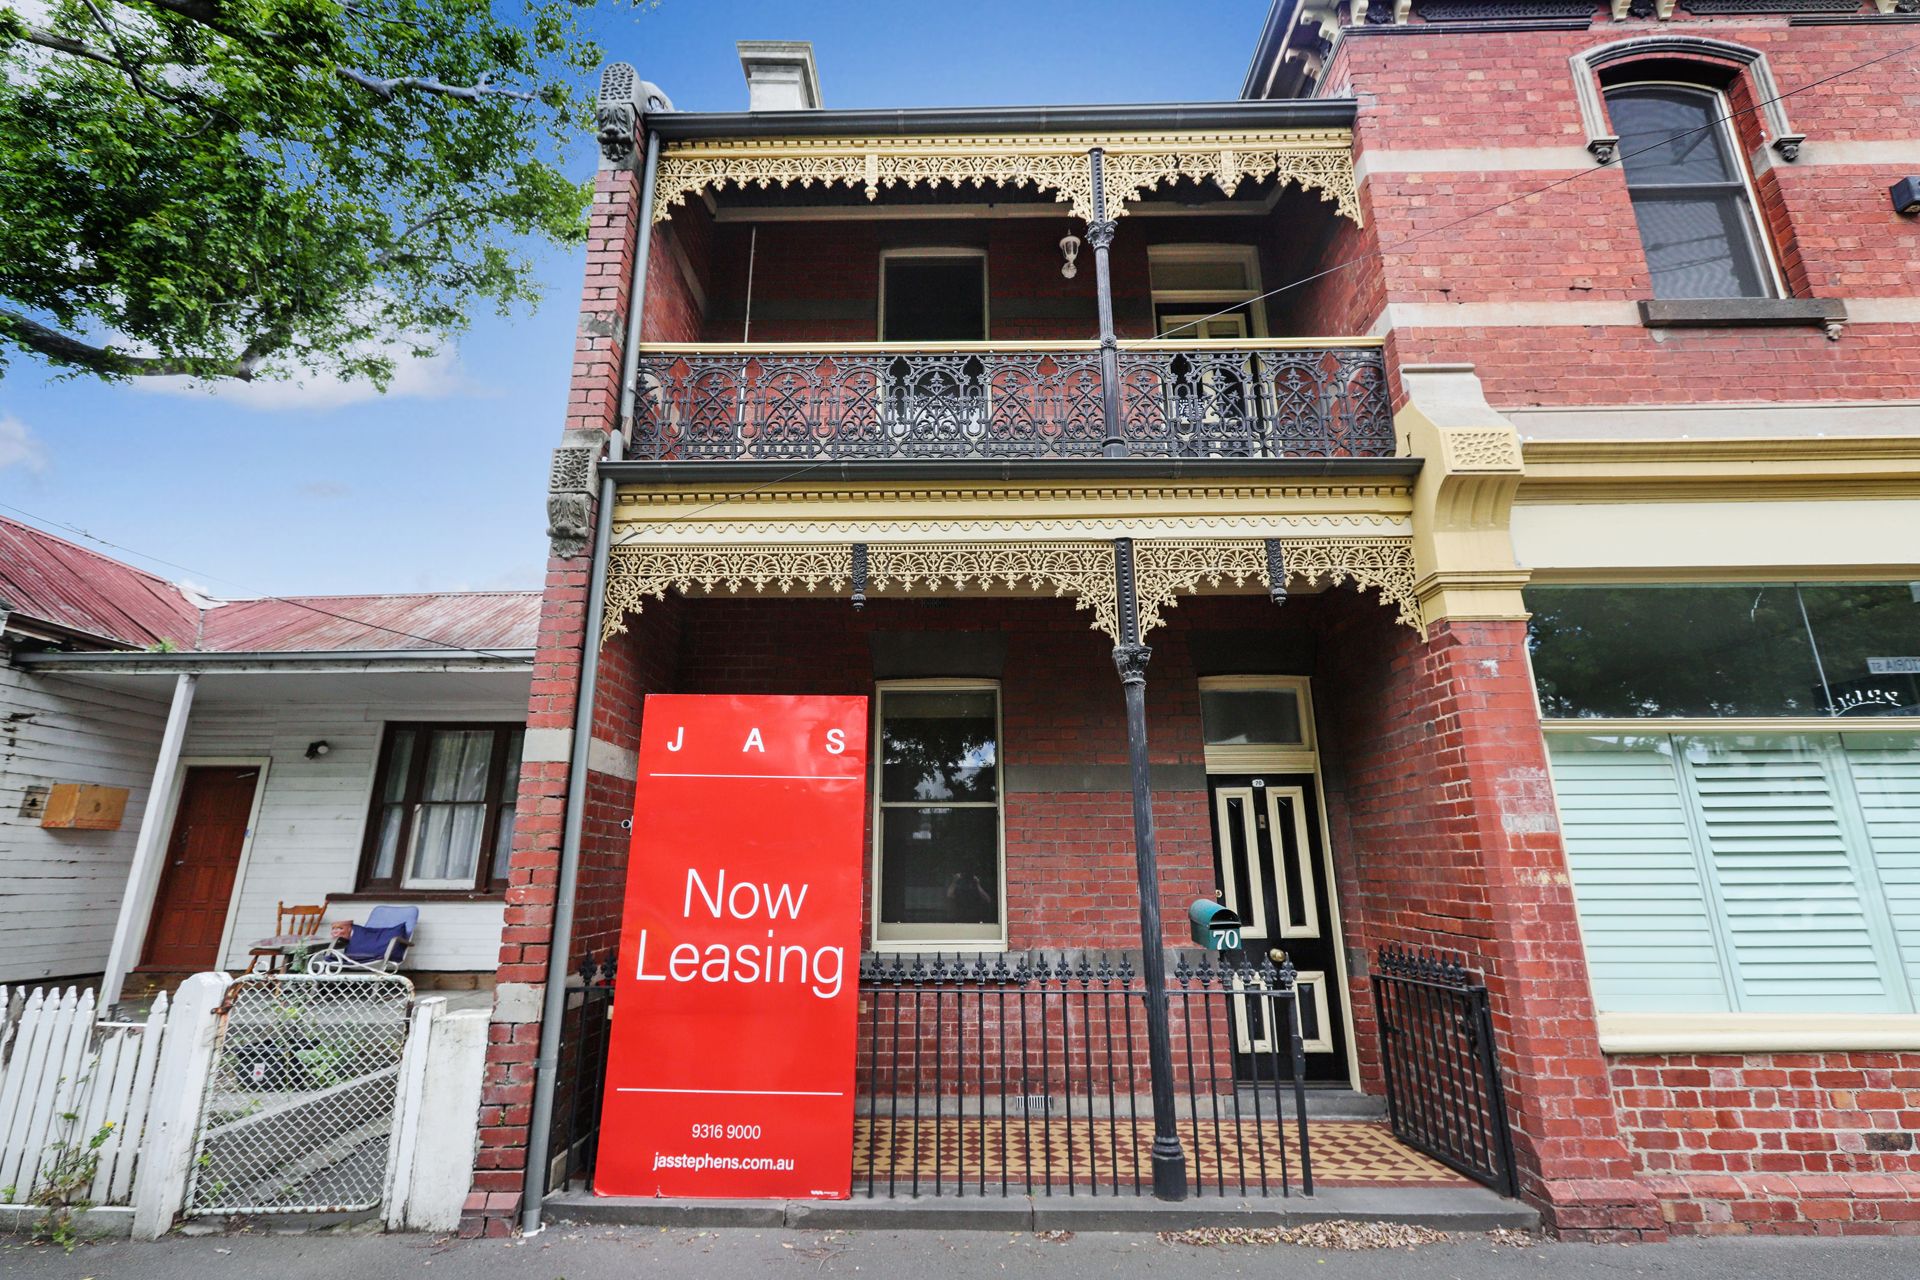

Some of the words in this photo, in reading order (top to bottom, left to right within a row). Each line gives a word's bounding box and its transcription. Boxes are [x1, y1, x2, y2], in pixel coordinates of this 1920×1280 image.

[667, 727, 684, 752] J
[742, 728, 765, 752] A
[825, 729, 846, 754] S
[683, 868, 808, 920] Now
[1213, 930, 1239, 950] 70
[636, 929, 844, 998] Leasing
[691, 1123, 723, 1139] 9316
[726, 1124, 761, 1140] 9000
[652, 1152, 795, 1172] jasstephens.com.au
